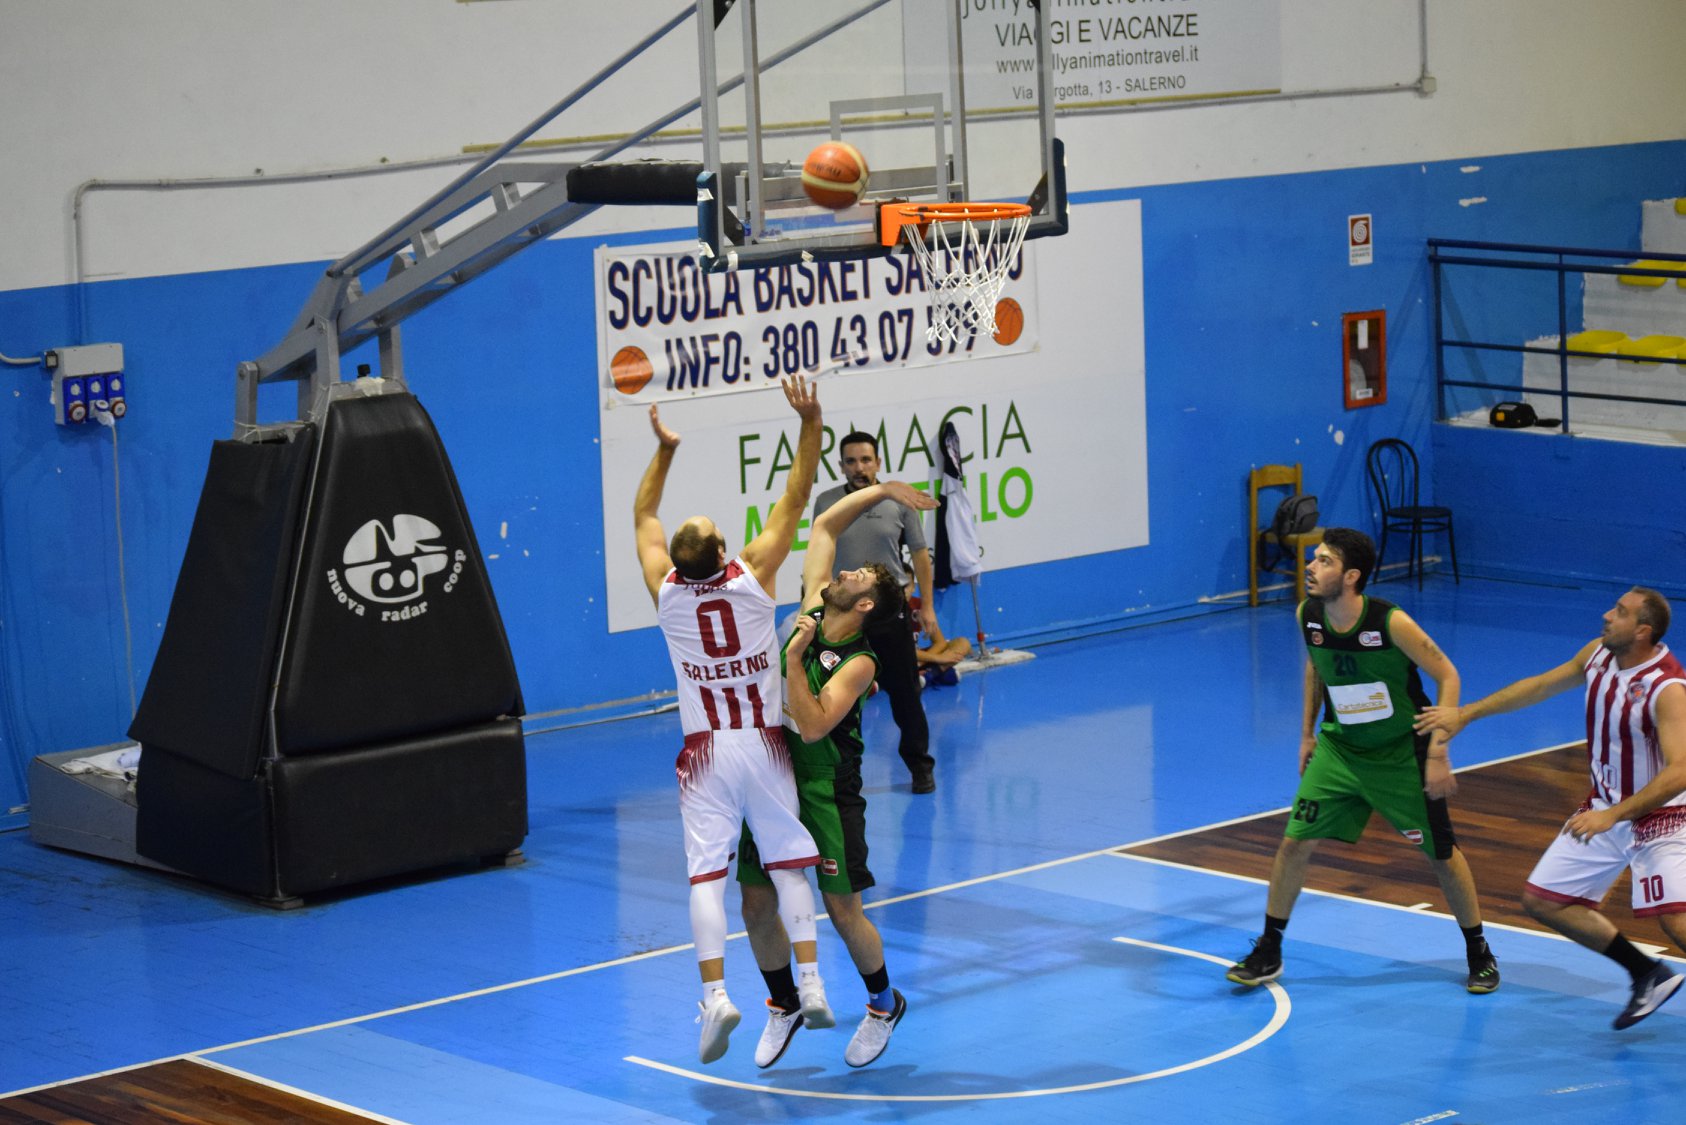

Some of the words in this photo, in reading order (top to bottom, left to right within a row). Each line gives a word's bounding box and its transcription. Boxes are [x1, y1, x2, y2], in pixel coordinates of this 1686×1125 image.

[995, 20, 1070, 47] VIAGI
[1078, 19, 1092, 43] E
[1099, 13, 1198, 41] VACANZE
[996, 45, 1199, 74] wwwllyanimationtravel.it
[1012, 85, 1033, 100] Via
[1099, 80, 1112, 94] 13
[1125, 74, 1186, 93] SALERNO
[608, 255, 744, 330] SCUOLA
[754, 257, 870, 313] BASKET
[665, 331, 751, 391] INFO:
[762, 320, 819, 378] 380
[830, 315, 870, 366] 43
[878, 307, 914, 362] 07
[326, 568, 366, 616] nuova
[381, 601, 428, 622] radar
[443, 549, 467, 593] coop
[696, 598, 742, 658] 0
[681, 651, 769, 681] SALERNO
[1333, 653, 1357, 677] 20
[1294, 798, 1319, 824] 20
[1640, 875, 1664, 903] 10
